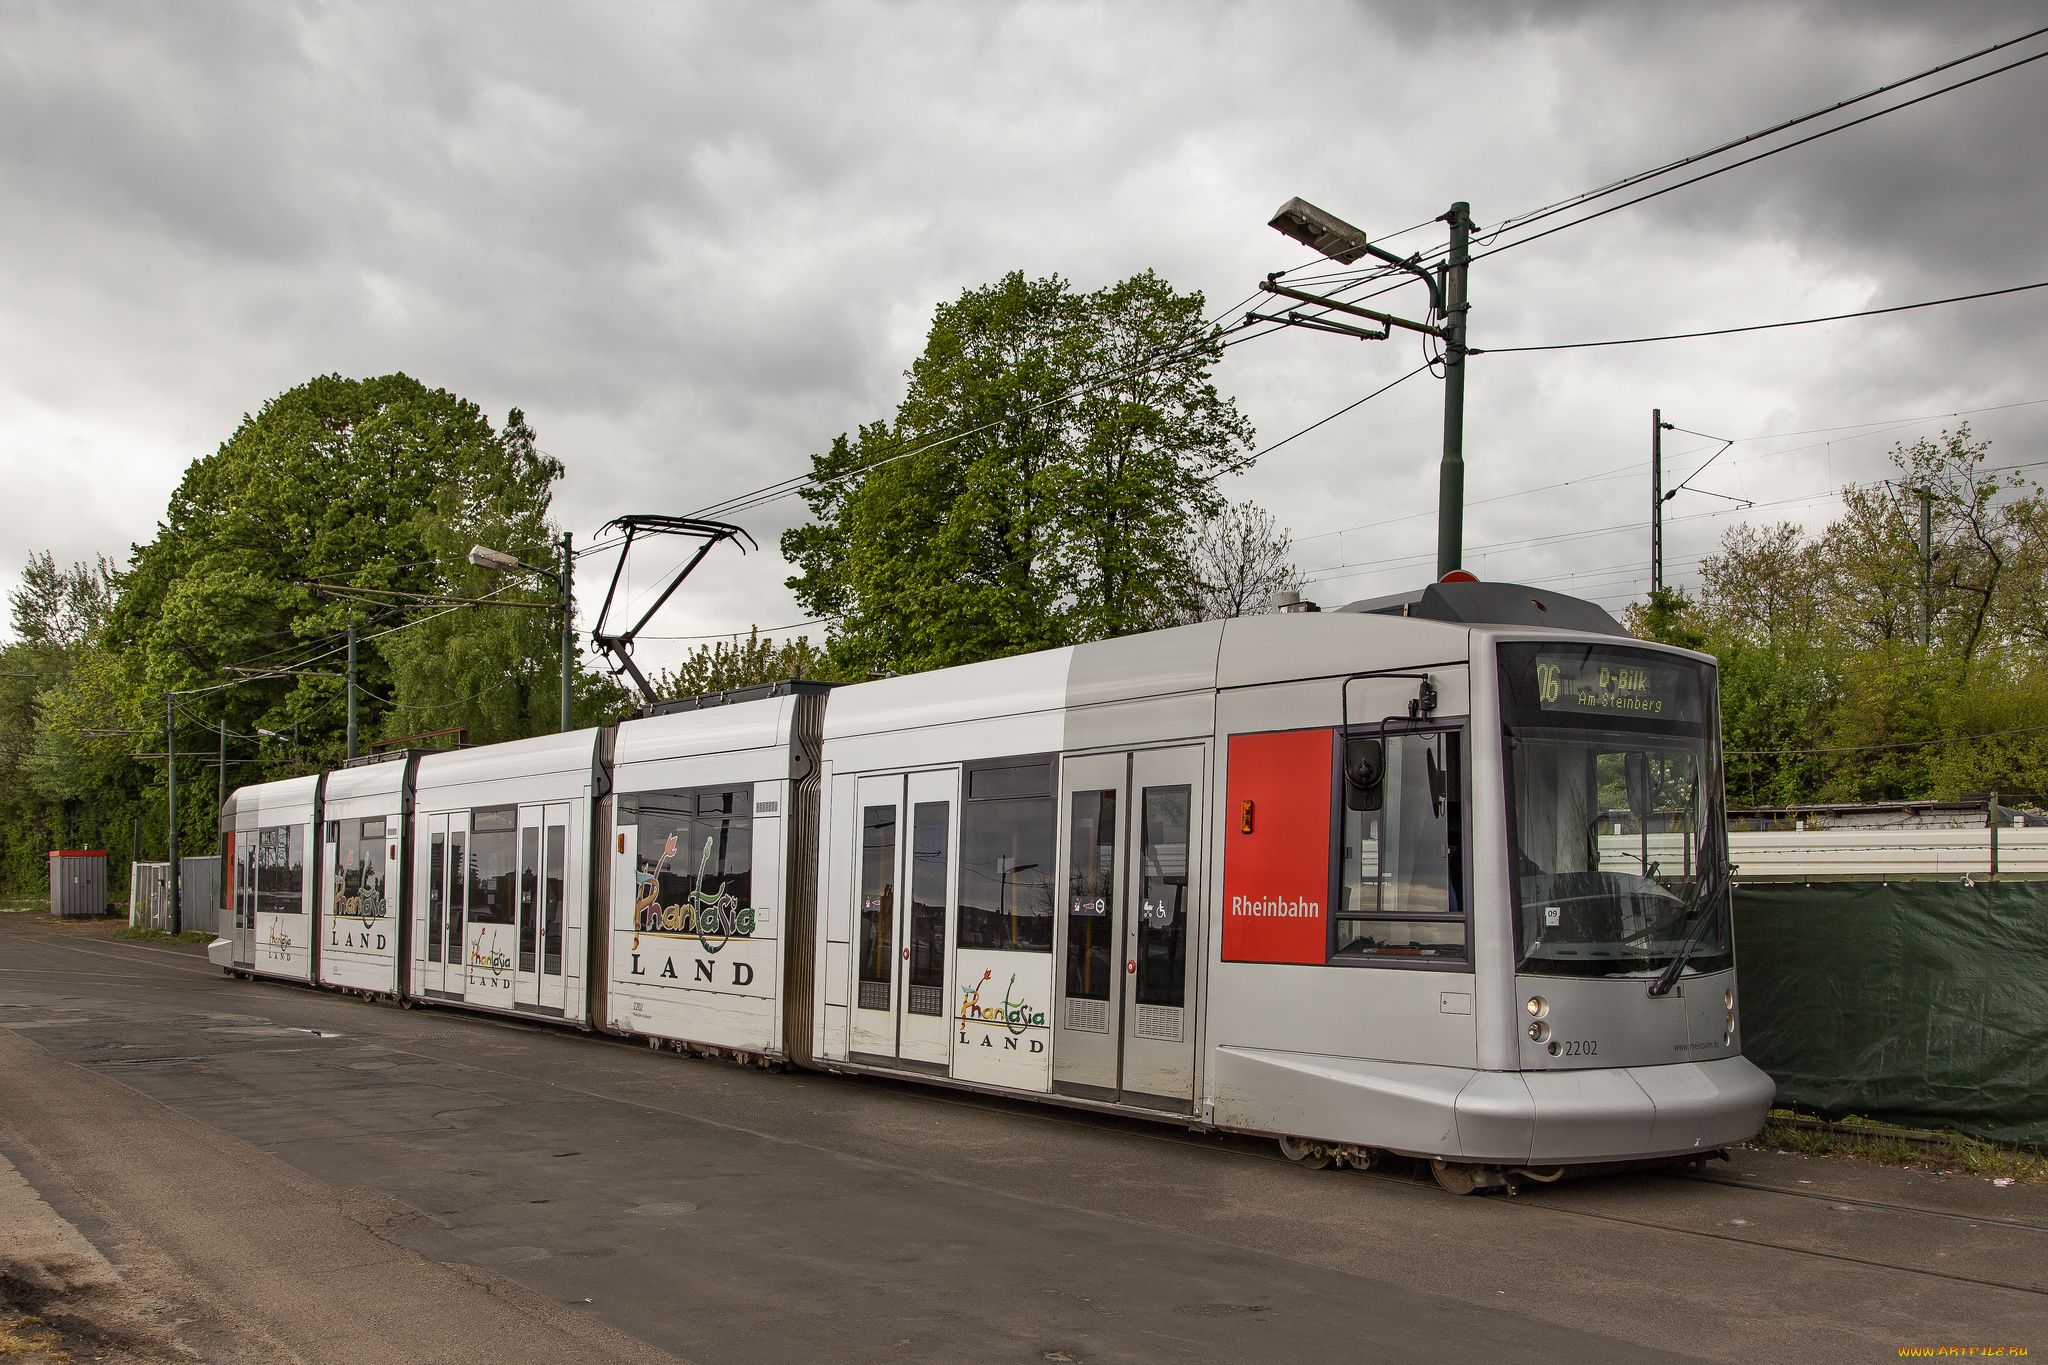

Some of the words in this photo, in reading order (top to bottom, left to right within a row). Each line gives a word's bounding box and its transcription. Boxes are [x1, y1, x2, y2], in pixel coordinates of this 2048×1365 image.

[1599, 667, 1648, 691] D-Bilk
[1578, 691, 1596, 706] Am
[1602, 692, 1662, 713] Steinberg
[1232, 895, 1319, 918] Rheinbahn
[1547, 910, 1558, 918] 09
[332, 930, 386, 951] LAND
[631, 953, 754, 986] LAND
[469, 974, 510, 989] LAND
[959, 1031, 1044, 1054] LAND
[1565, 1040, 1598, 1056] 2202
